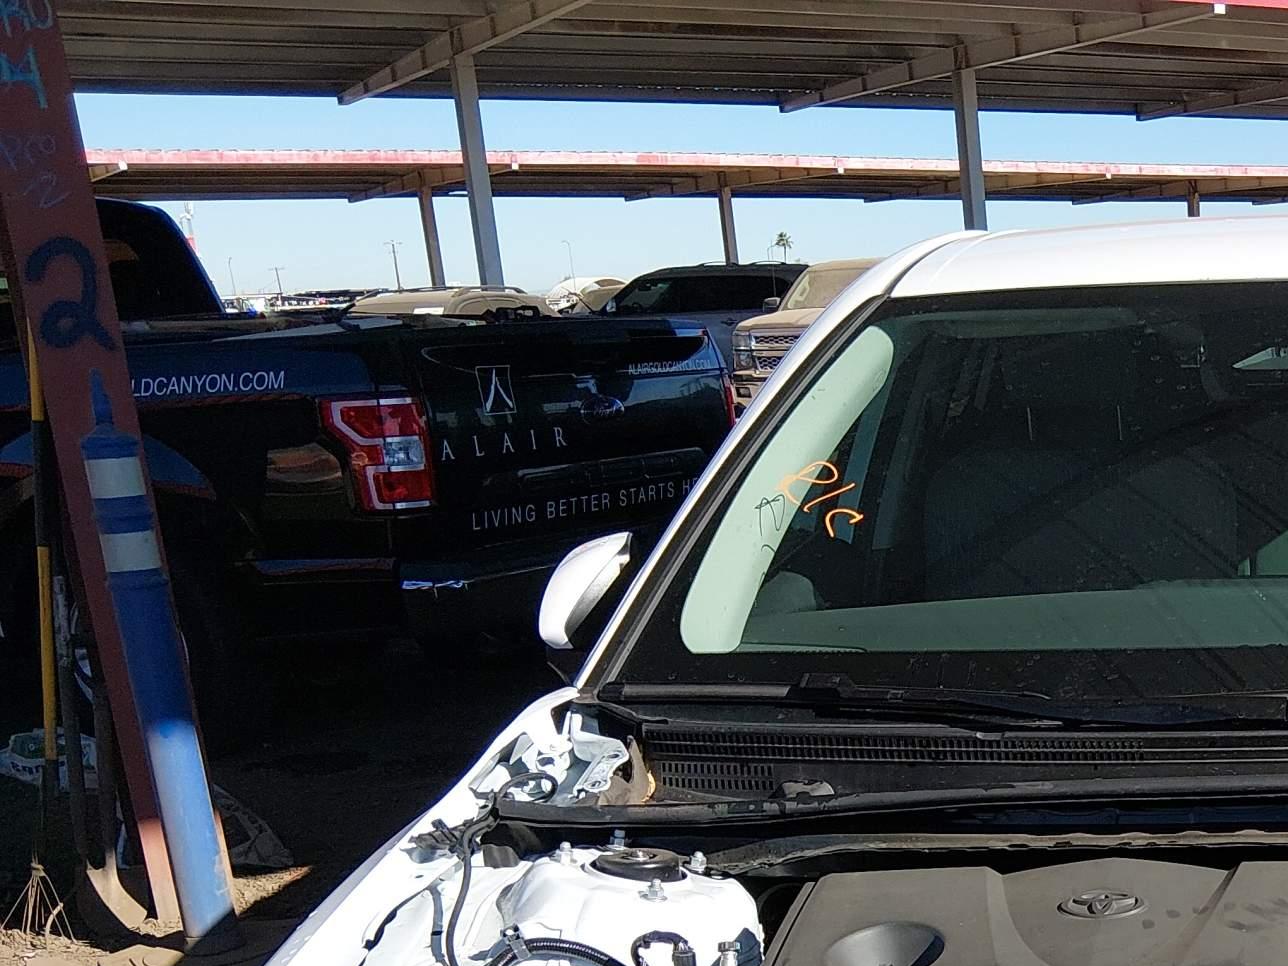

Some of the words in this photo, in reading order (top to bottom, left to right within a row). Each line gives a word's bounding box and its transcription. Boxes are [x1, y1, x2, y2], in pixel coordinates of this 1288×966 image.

[24, 235, 117, 352] 2
[131, 370, 285, 397] LDCANYON.COM
[441, 426, 567, 461] ALAIR
[472, 504, 536, 530] LIVING
[547, 492, 610, 519] BETTER
[619, 483, 675, 507] STARTS
